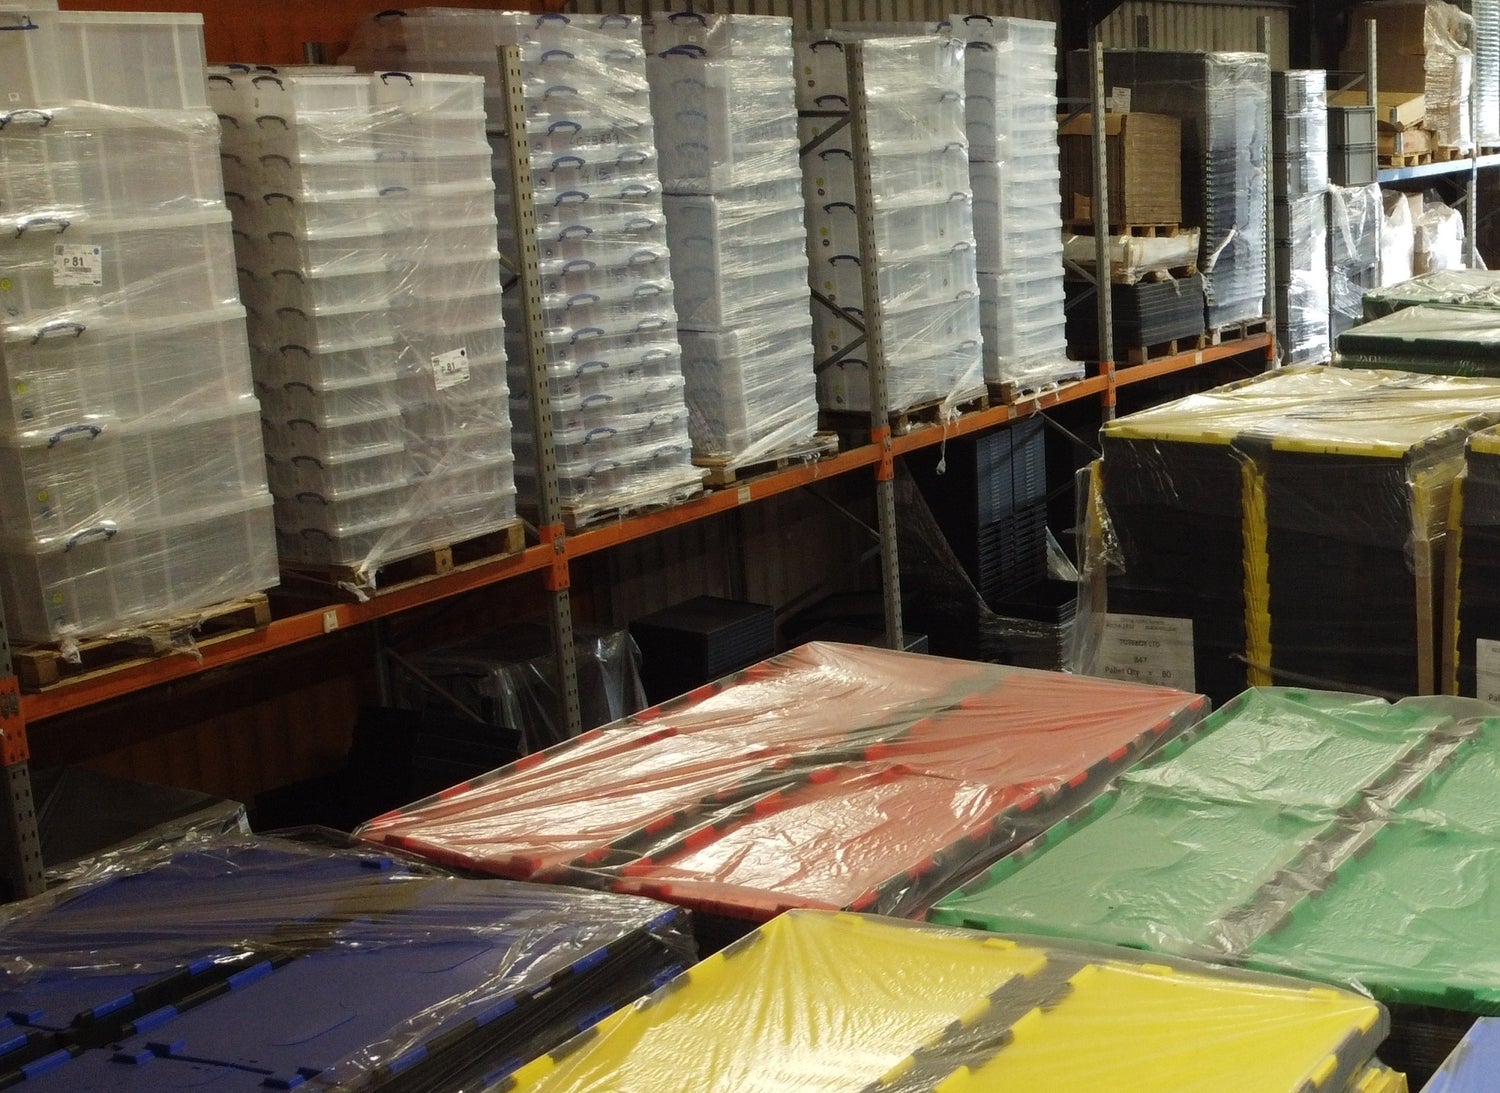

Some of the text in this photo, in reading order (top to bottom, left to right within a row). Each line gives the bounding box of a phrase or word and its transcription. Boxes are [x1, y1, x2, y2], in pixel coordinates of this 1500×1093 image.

[64, 256, 84, 267] P 81
[1105, 665, 1125, 675] Pallet
[1126, 667, 1139, 677] Qty
[1162, 670, 1172, 678] 80
